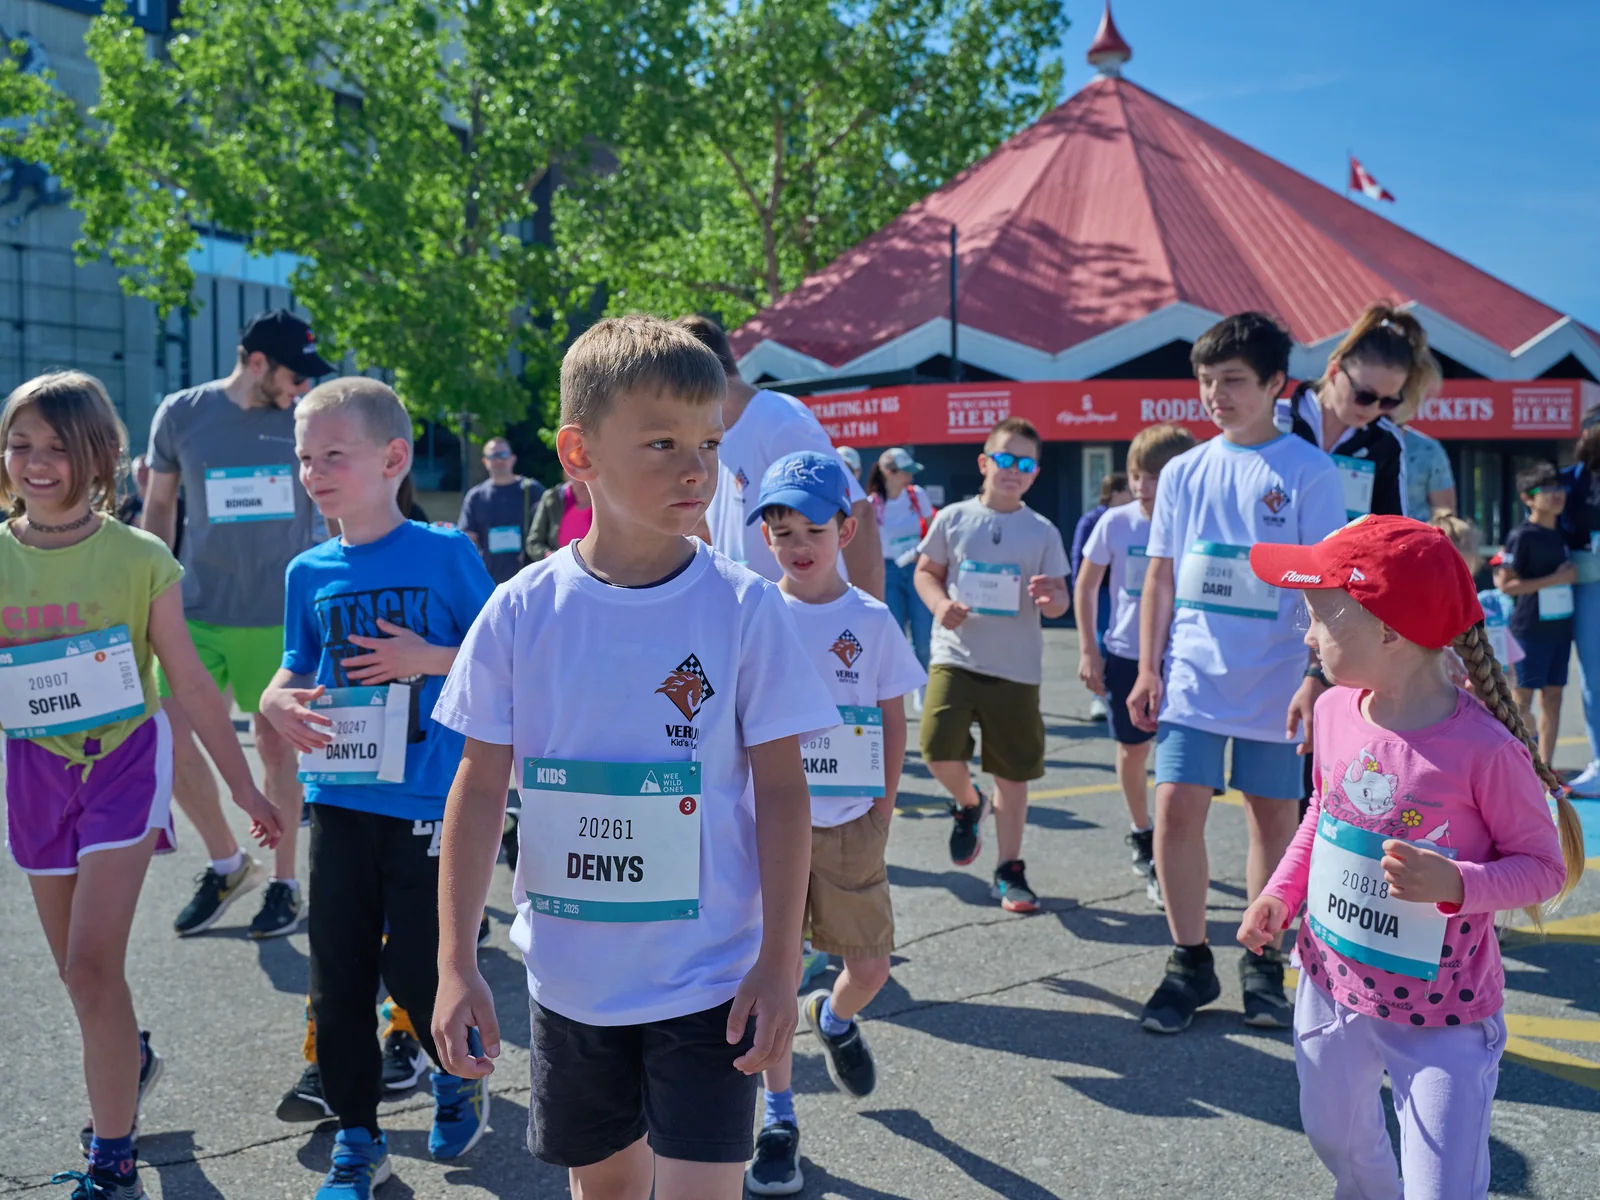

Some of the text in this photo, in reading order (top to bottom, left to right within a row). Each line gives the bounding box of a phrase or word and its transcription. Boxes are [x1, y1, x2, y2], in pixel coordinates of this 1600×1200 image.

[864, 399, 878, 415] AT
[1417, 397, 1493, 421] ICKETS
[1513, 407, 1571, 423] HERE
[1281, 569, 1321, 584] Flames
[1202, 581, 1232, 597] DARII
[2, 602, 86, 631] GIRL
[29, 672, 68, 690] 20907
[119, 661, 135, 690] 20907
[29, 692, 81, 715] SOFIIA
[337, 721, 366, 735] 20247
[326, 742, 377, 760] DANYLO
[671, 739, 689, 747] Kid's
[803, 736, 830, 749] 679
[871, 741, 879, 770] 20679
[803, 758, 838, 774] AKAR
[537, 767, 567, 785] KIDS
[663, 779, 682, 787] WILD
[684, 801, 691, 811] 3
[579, 816, 634, 840] 20261
[567, 852, 644, 883] DENYS
[1342, 869, 1389, 899] 20818
[564, 903, 579, 914] 2025
[1328, 893, 1399, 939] POPOVA
